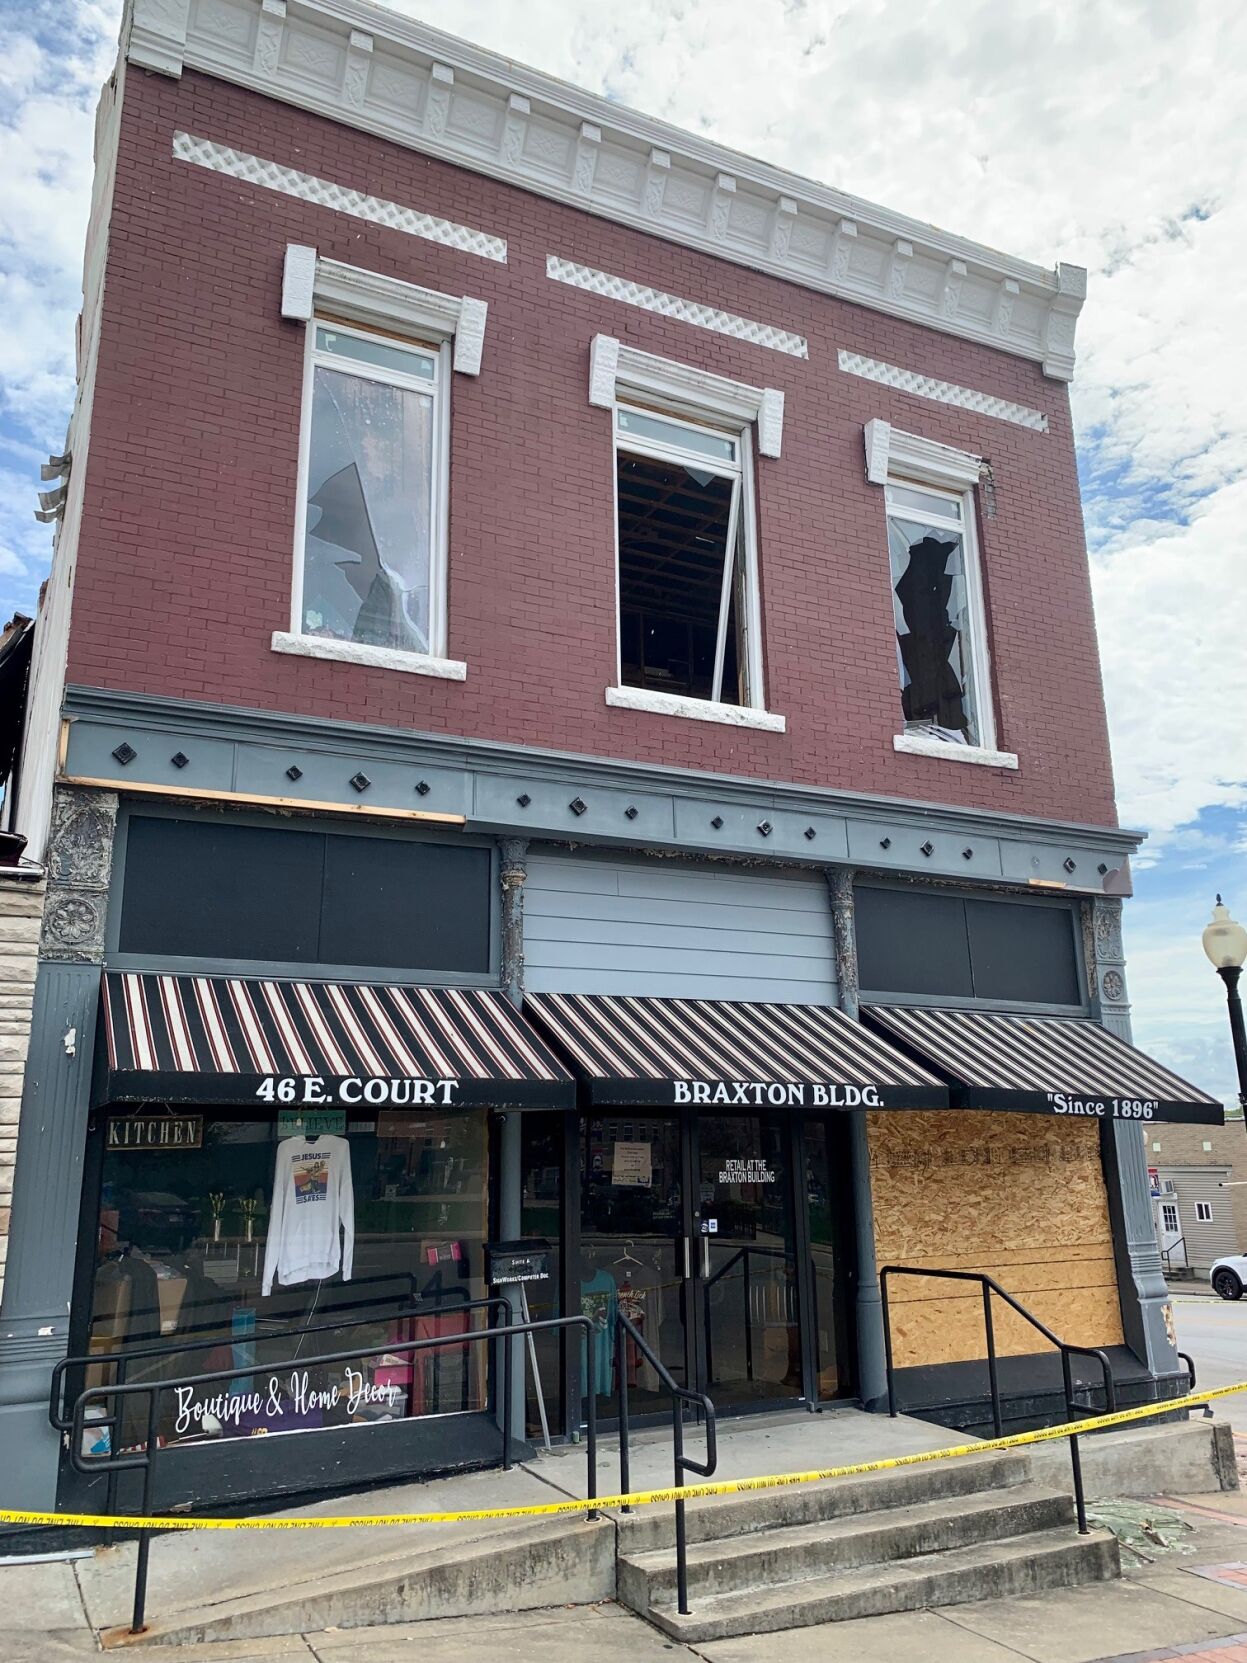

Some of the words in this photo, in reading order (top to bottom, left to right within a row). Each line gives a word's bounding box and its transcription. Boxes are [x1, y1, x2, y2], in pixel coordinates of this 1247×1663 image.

[256, 1078, 296, 1102] 46
[303, 1078, 332, 1103] E.
[339, 1078, 459, 1104] COURT
[674, 1081, 804, 1105] BRAXTON
[813, 1085, 884, 1107] BLDG.
[1047, 1094, 1105, 1115] "Since
[1112, 1100, 1159, 1118] 1896"
[109, 1120, 196, 1145] KITCHEN
[281, 1115, 345, 1133] BEIEVE
[301, 1153, 322, 1161] JESUS
[725, 1159, 746, 1172] RETAIL
[747, 1159, 755, 1171] AT
[755, 1159, 767, 1171] THE
[718, 1171, 747, 1184] BRAXTON
[747, 1170, 775, 1183] BUILDING
[174, 1386, 263, 1433] Boutique
[267, 1376, 284, 1416] &
[290, 1371, 341, 1415] Home
[344, 1366, 398, 1415] Decor
